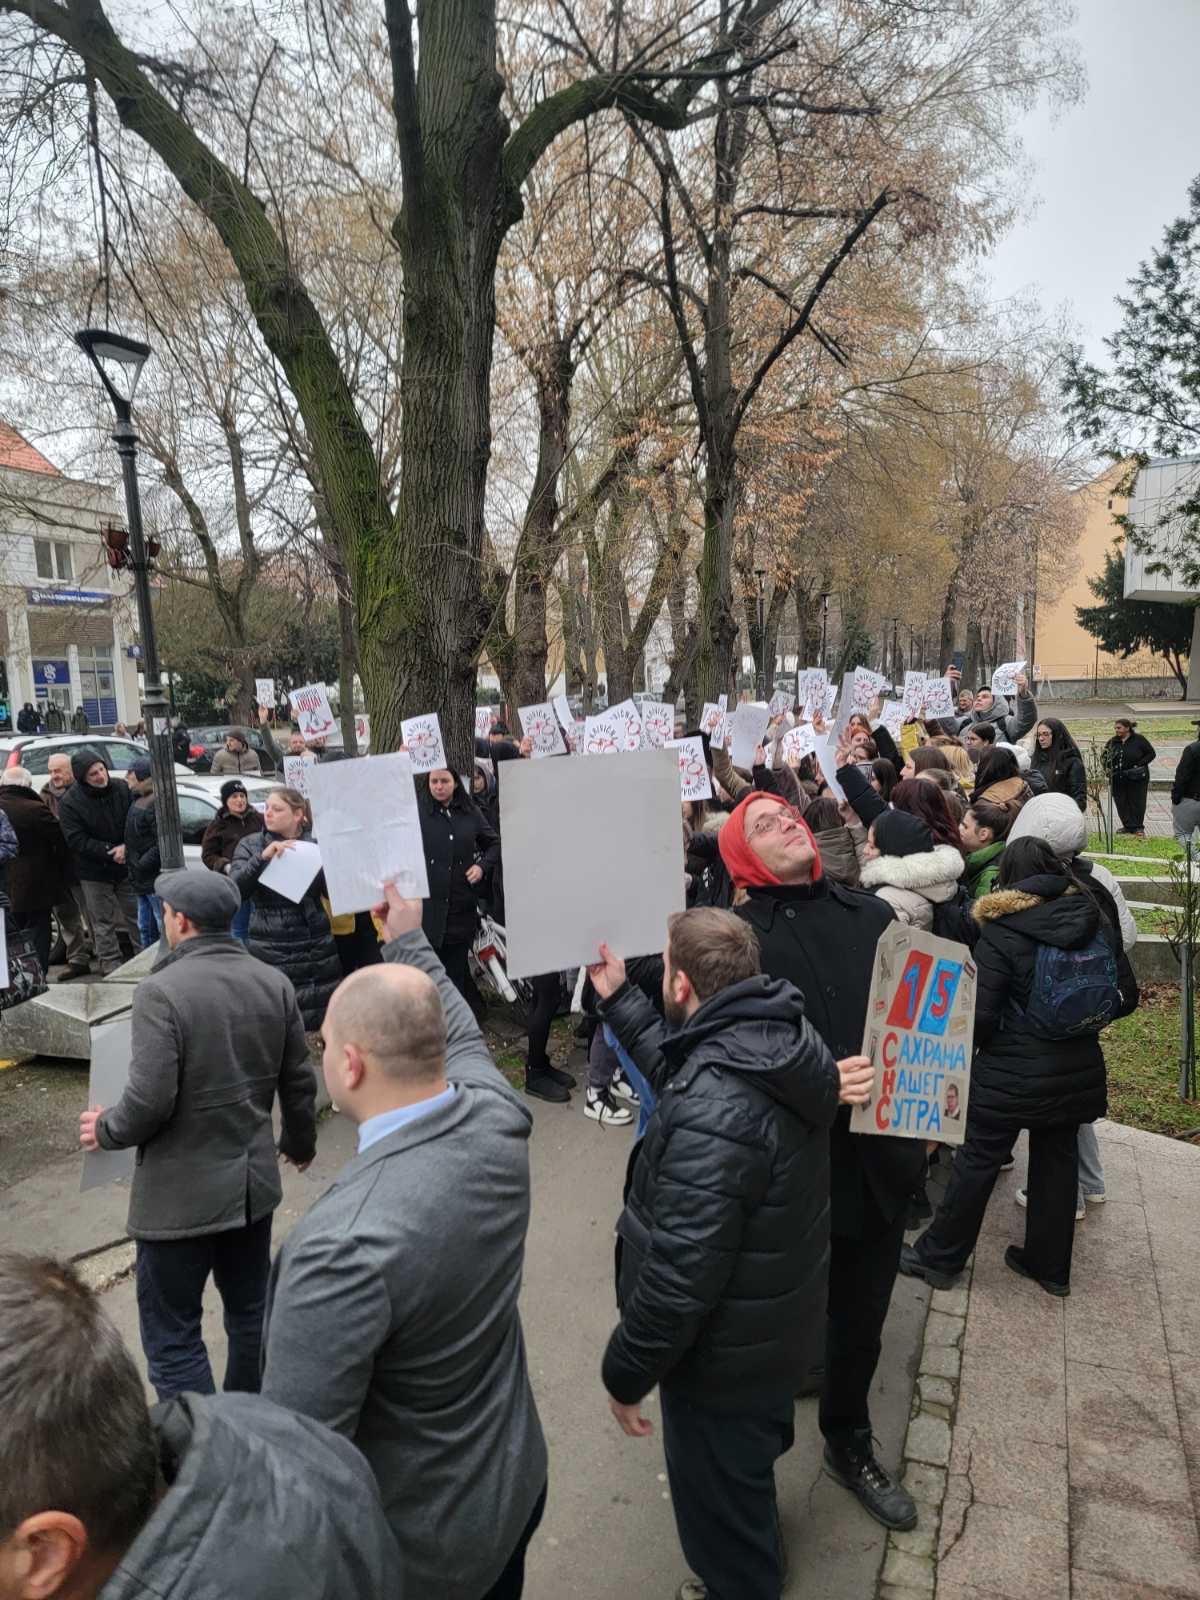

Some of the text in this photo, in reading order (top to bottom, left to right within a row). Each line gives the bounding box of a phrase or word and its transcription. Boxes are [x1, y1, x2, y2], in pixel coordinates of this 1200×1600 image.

[882, 1032, 966, 1071] САХРАНА
[882, 1069, 945, 1096] НАШЕГ
[876, 1095, 942, 1133] СУТРА
